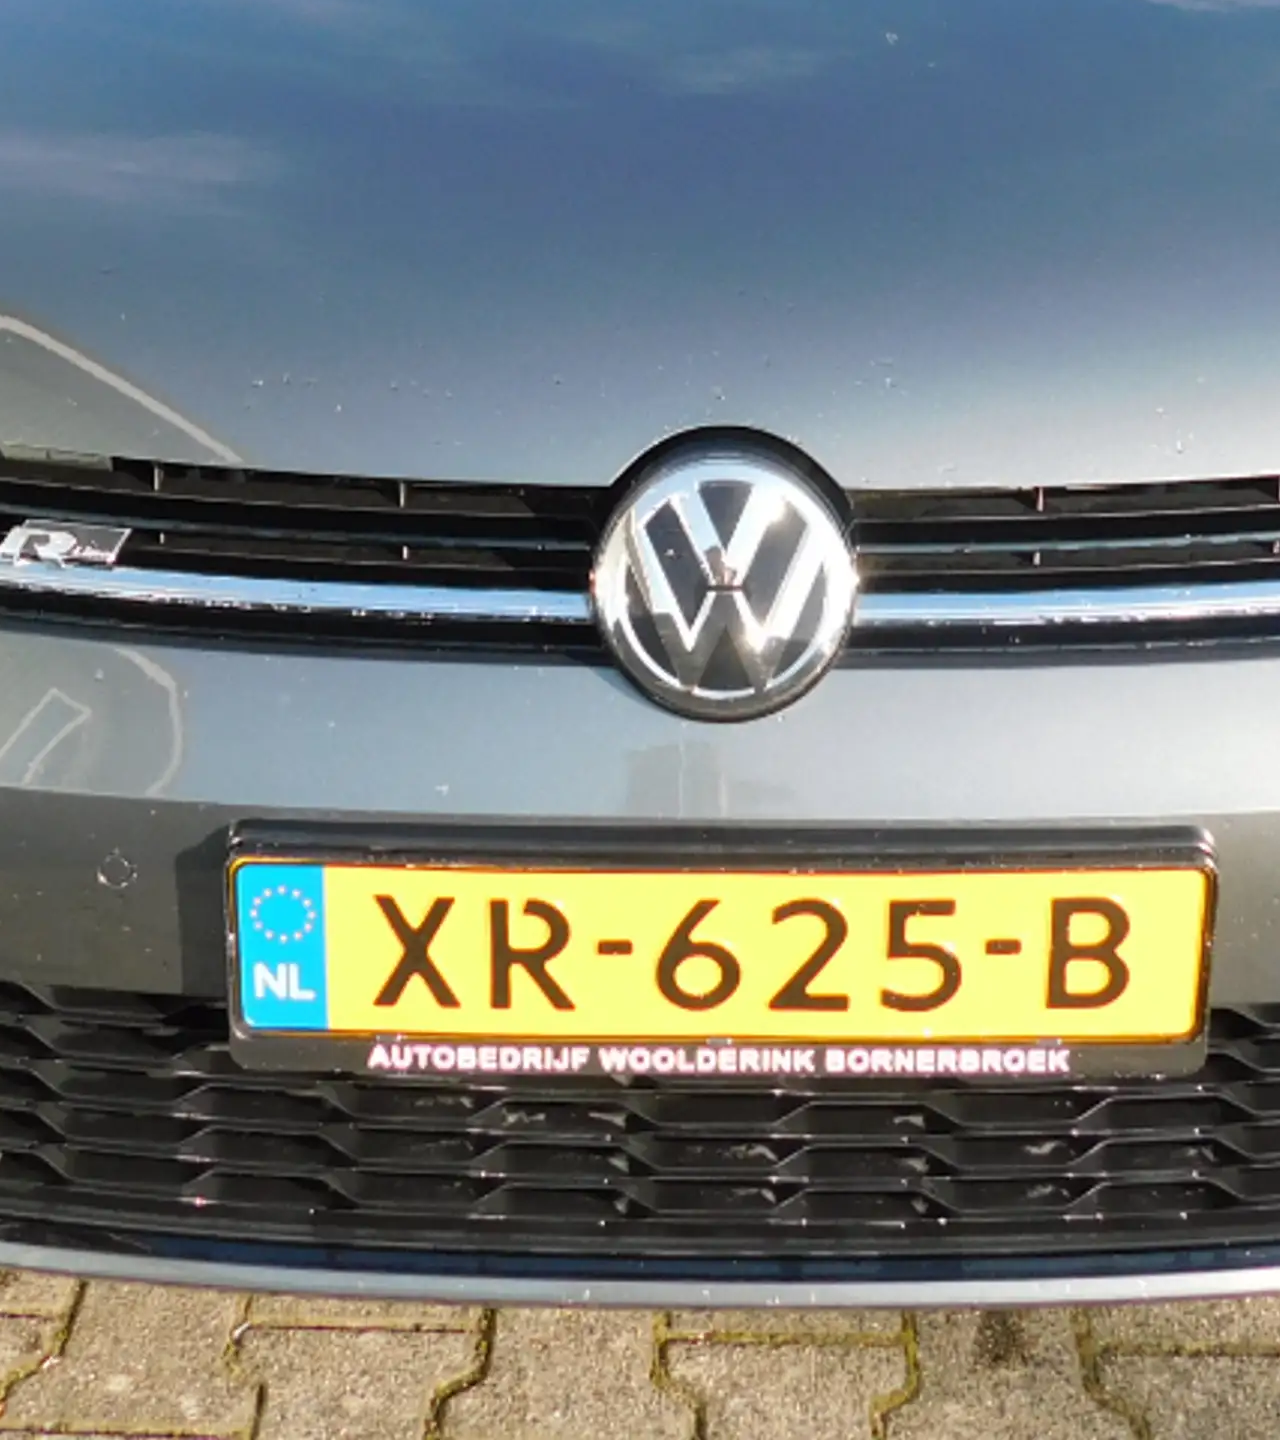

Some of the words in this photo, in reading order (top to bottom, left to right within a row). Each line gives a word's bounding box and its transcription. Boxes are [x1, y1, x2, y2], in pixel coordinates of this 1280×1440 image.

[373, 893, 1132, 1012] XR-625-B
[253, 961, 317, 1001] NL
[366, 1044, 590, 1073] AUTOBEDRIJF
[597, 1046, 817, 1074] WOOLDERINK
[824, 1047, 1070, 1074] BORNERBROEK
